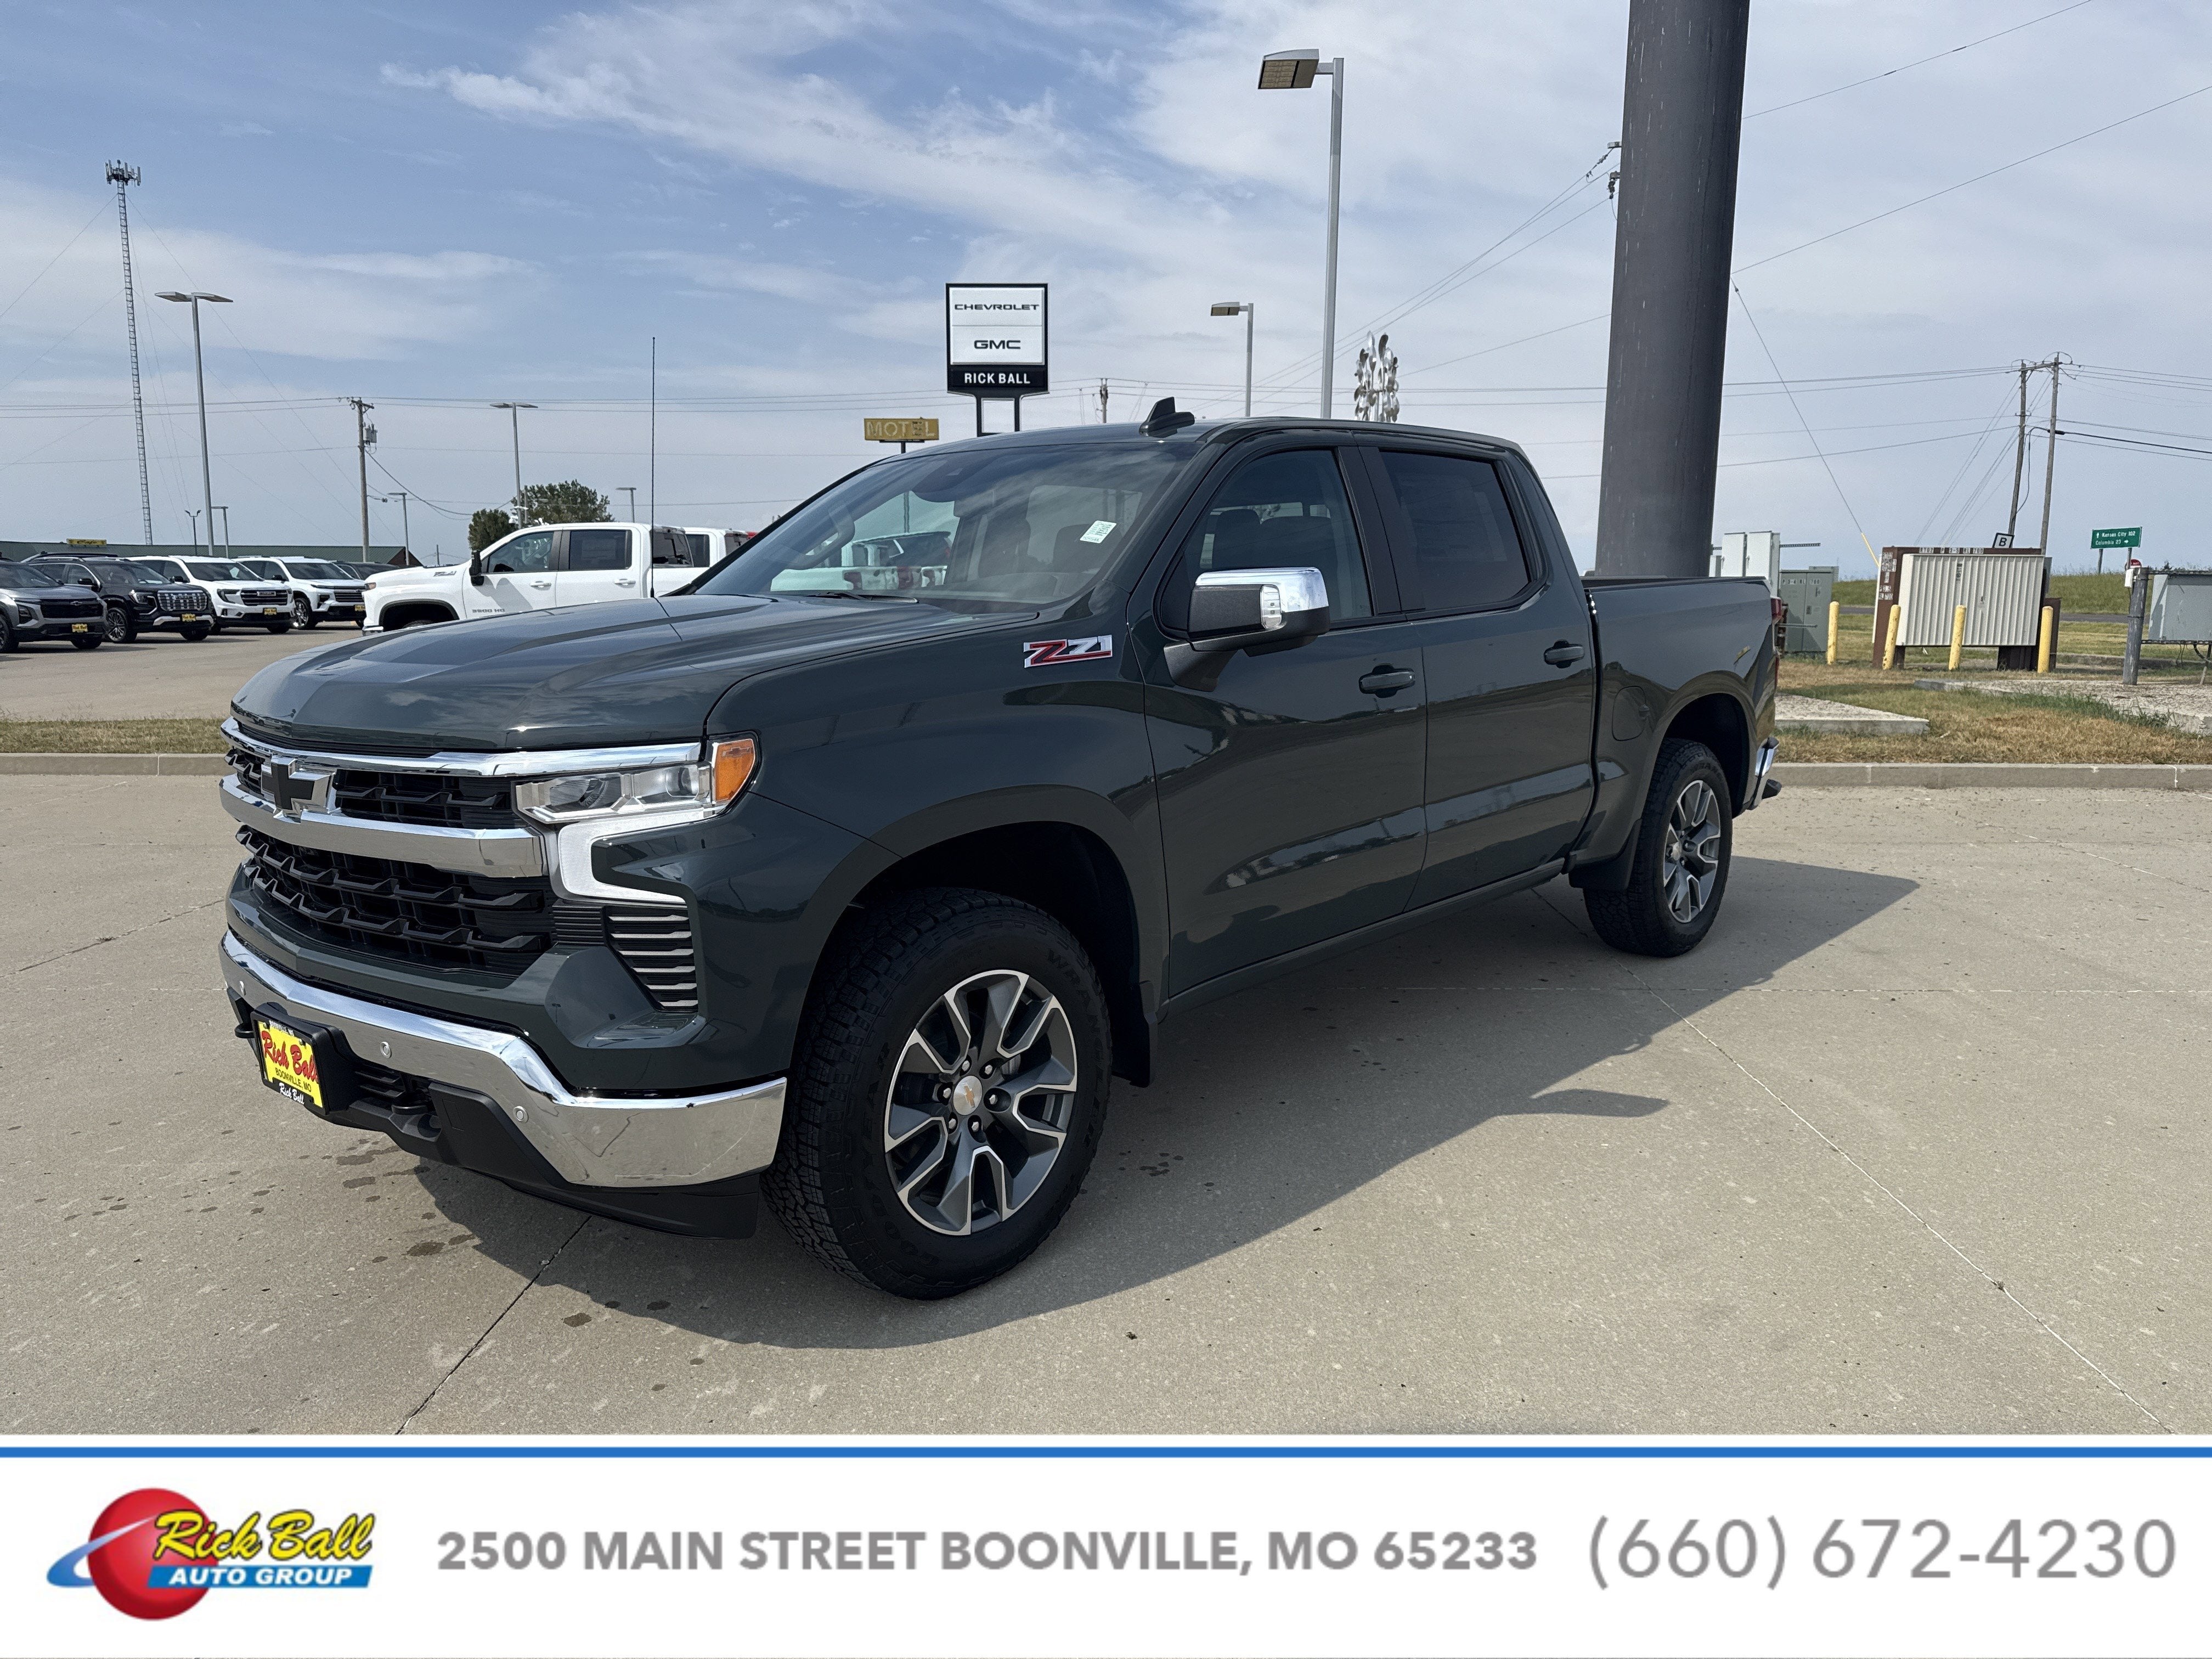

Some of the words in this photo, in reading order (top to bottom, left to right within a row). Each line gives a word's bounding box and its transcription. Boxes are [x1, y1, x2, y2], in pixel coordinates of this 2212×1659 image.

[974, 340, 1022, 349] GMC
[964, 373, 995, 384] RICK
[998, 372, 1031, 384] BALL
[1999, 537, 2007, 547] B
[1023, 634, 1113, 668] Z71
[261, 1030, 290, 1070] Rick
[290, 1045, 319, 1084] Ball
[303, 1081, 312, 1092] MO
[279, 1082, 292, 1099] Rick
[292, 1088, 305, 1105] Ball
